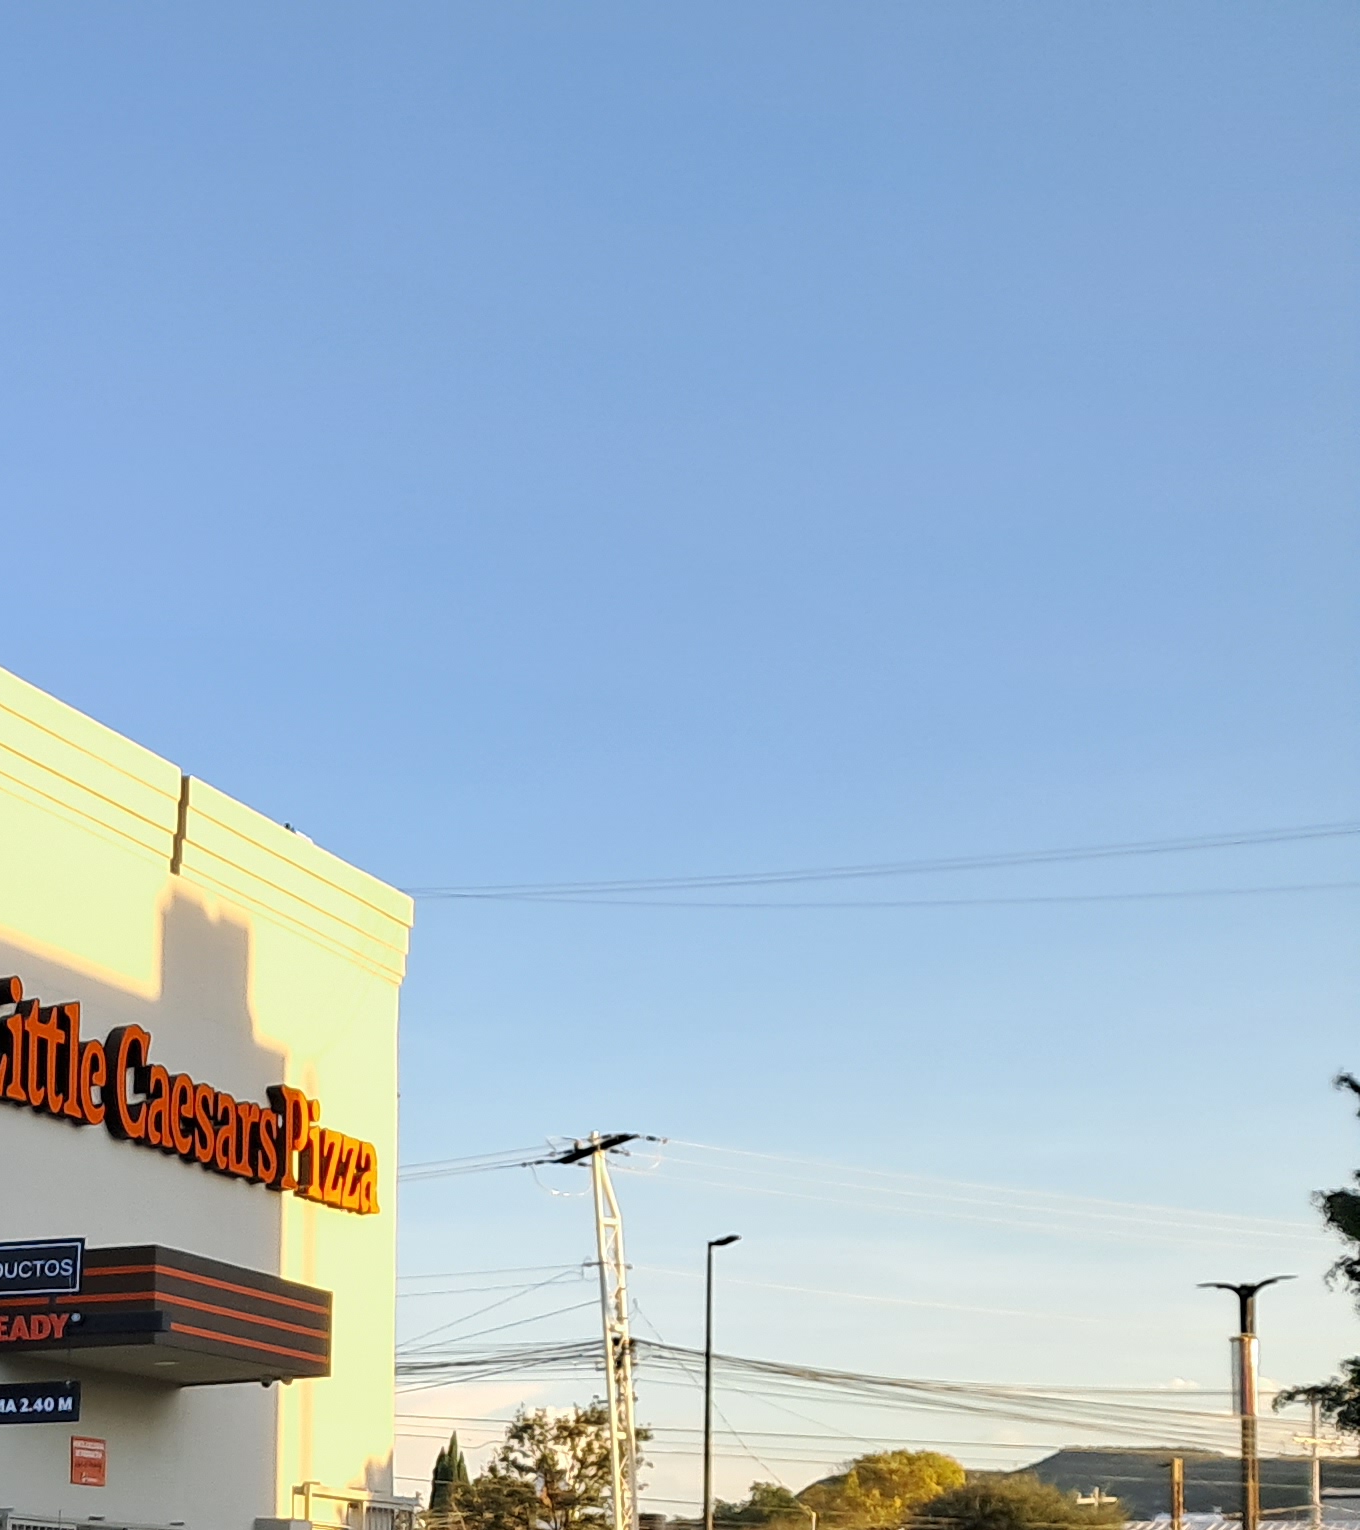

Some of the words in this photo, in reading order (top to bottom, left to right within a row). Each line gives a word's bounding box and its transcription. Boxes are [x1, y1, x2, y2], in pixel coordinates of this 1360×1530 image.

[281, 1084, 380, 1215] Pizza
[19, 1397, 55, 1412] 2.40
[58, 1396, 73, 1411] M
